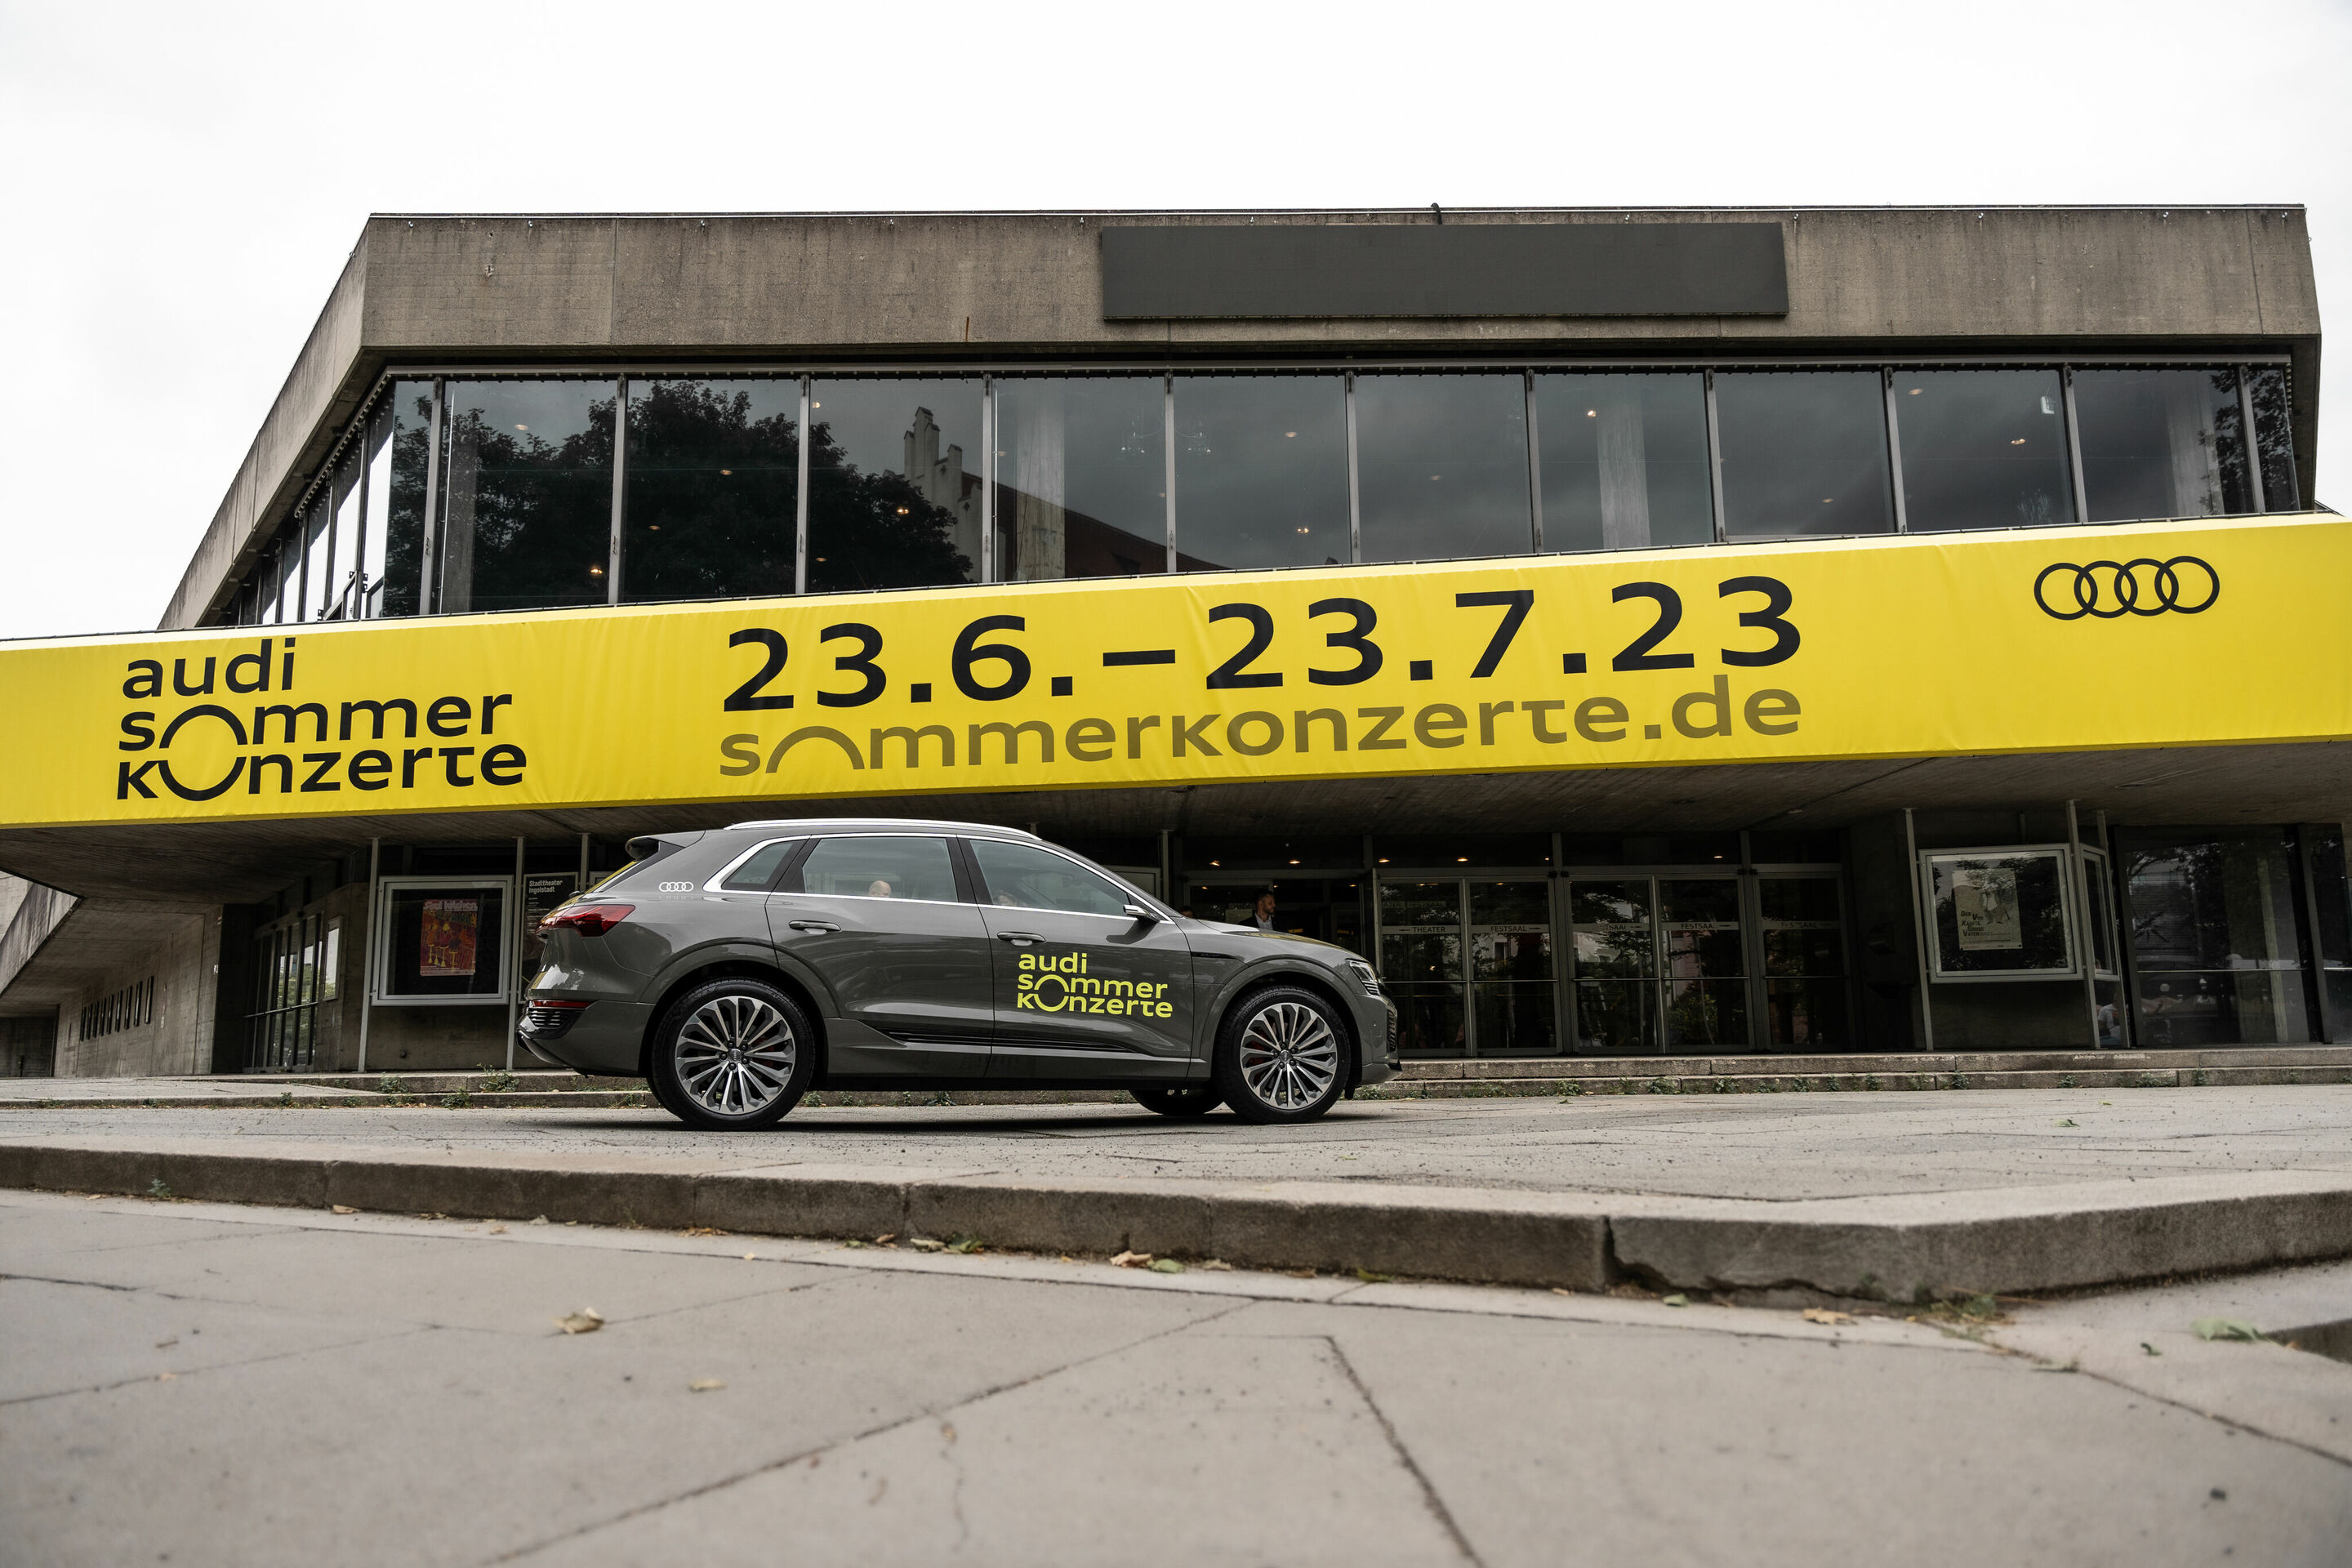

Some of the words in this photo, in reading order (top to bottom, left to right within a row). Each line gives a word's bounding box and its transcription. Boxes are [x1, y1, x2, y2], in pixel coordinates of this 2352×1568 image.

[123, 638, 296, 698] audi
[119, 694, 511, 751] sommer
[720, 675, 1801, 776] sommerkonzerte.de
[118, 744, 526, 801] konzerte
[1018, 974, 1168, 998] sommer
[1019, 952, 1086, 973] audi
[1018, 991, 1172, 1018] konzerte
